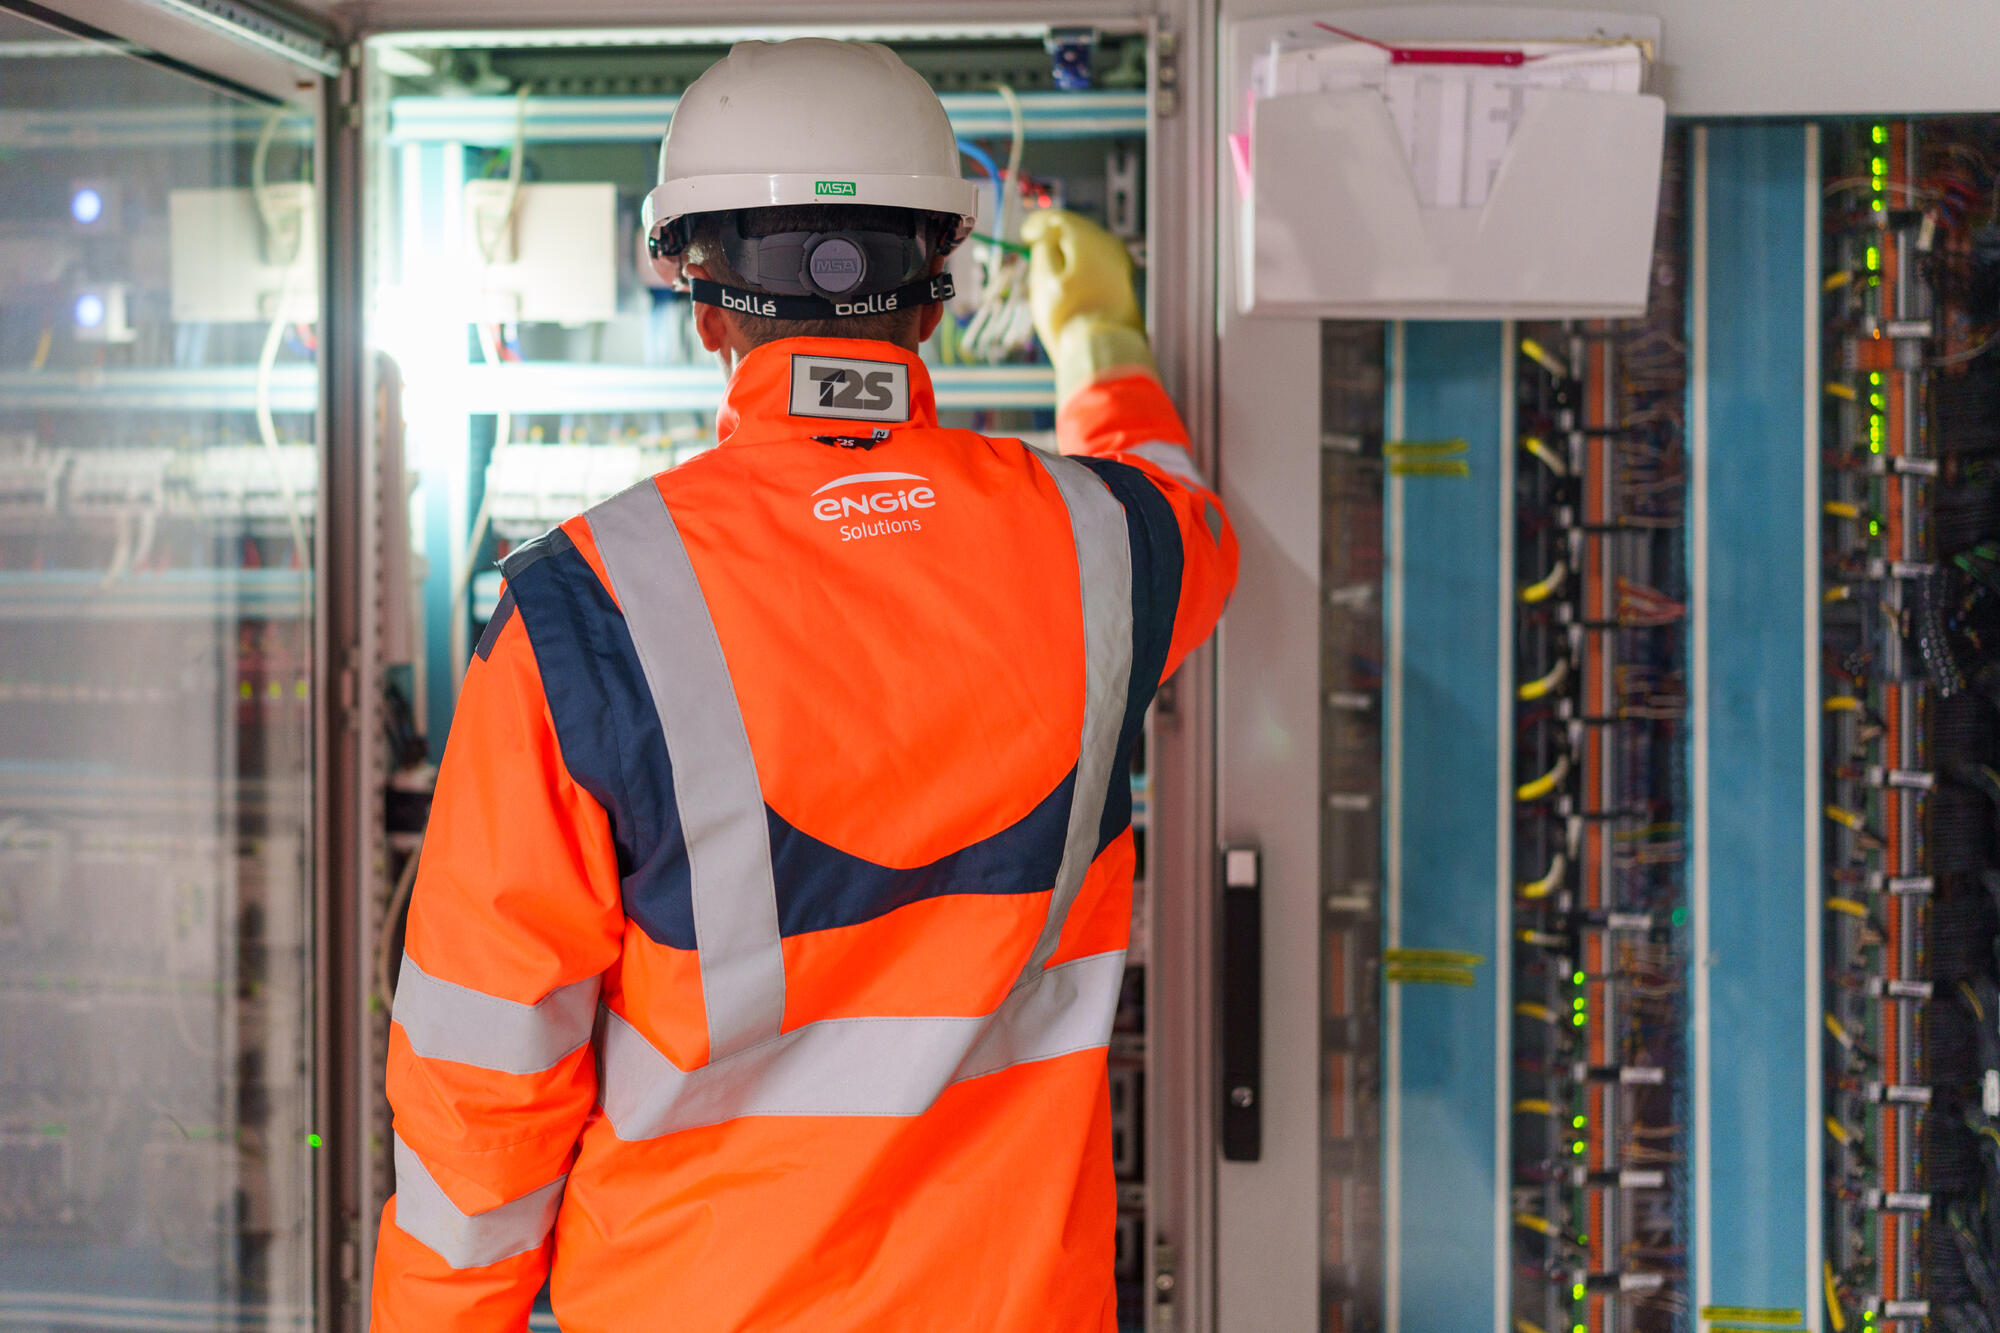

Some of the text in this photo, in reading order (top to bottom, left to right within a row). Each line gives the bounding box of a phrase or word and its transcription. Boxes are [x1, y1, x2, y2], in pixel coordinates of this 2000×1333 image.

[817, 182, 855, 195] MSA
[815, 259, 857, 273] MSA
[721, 288, 777, 317] bollé
[809, 365, 894, 412] T2S
[839, 518, 922, 542] Solutions
